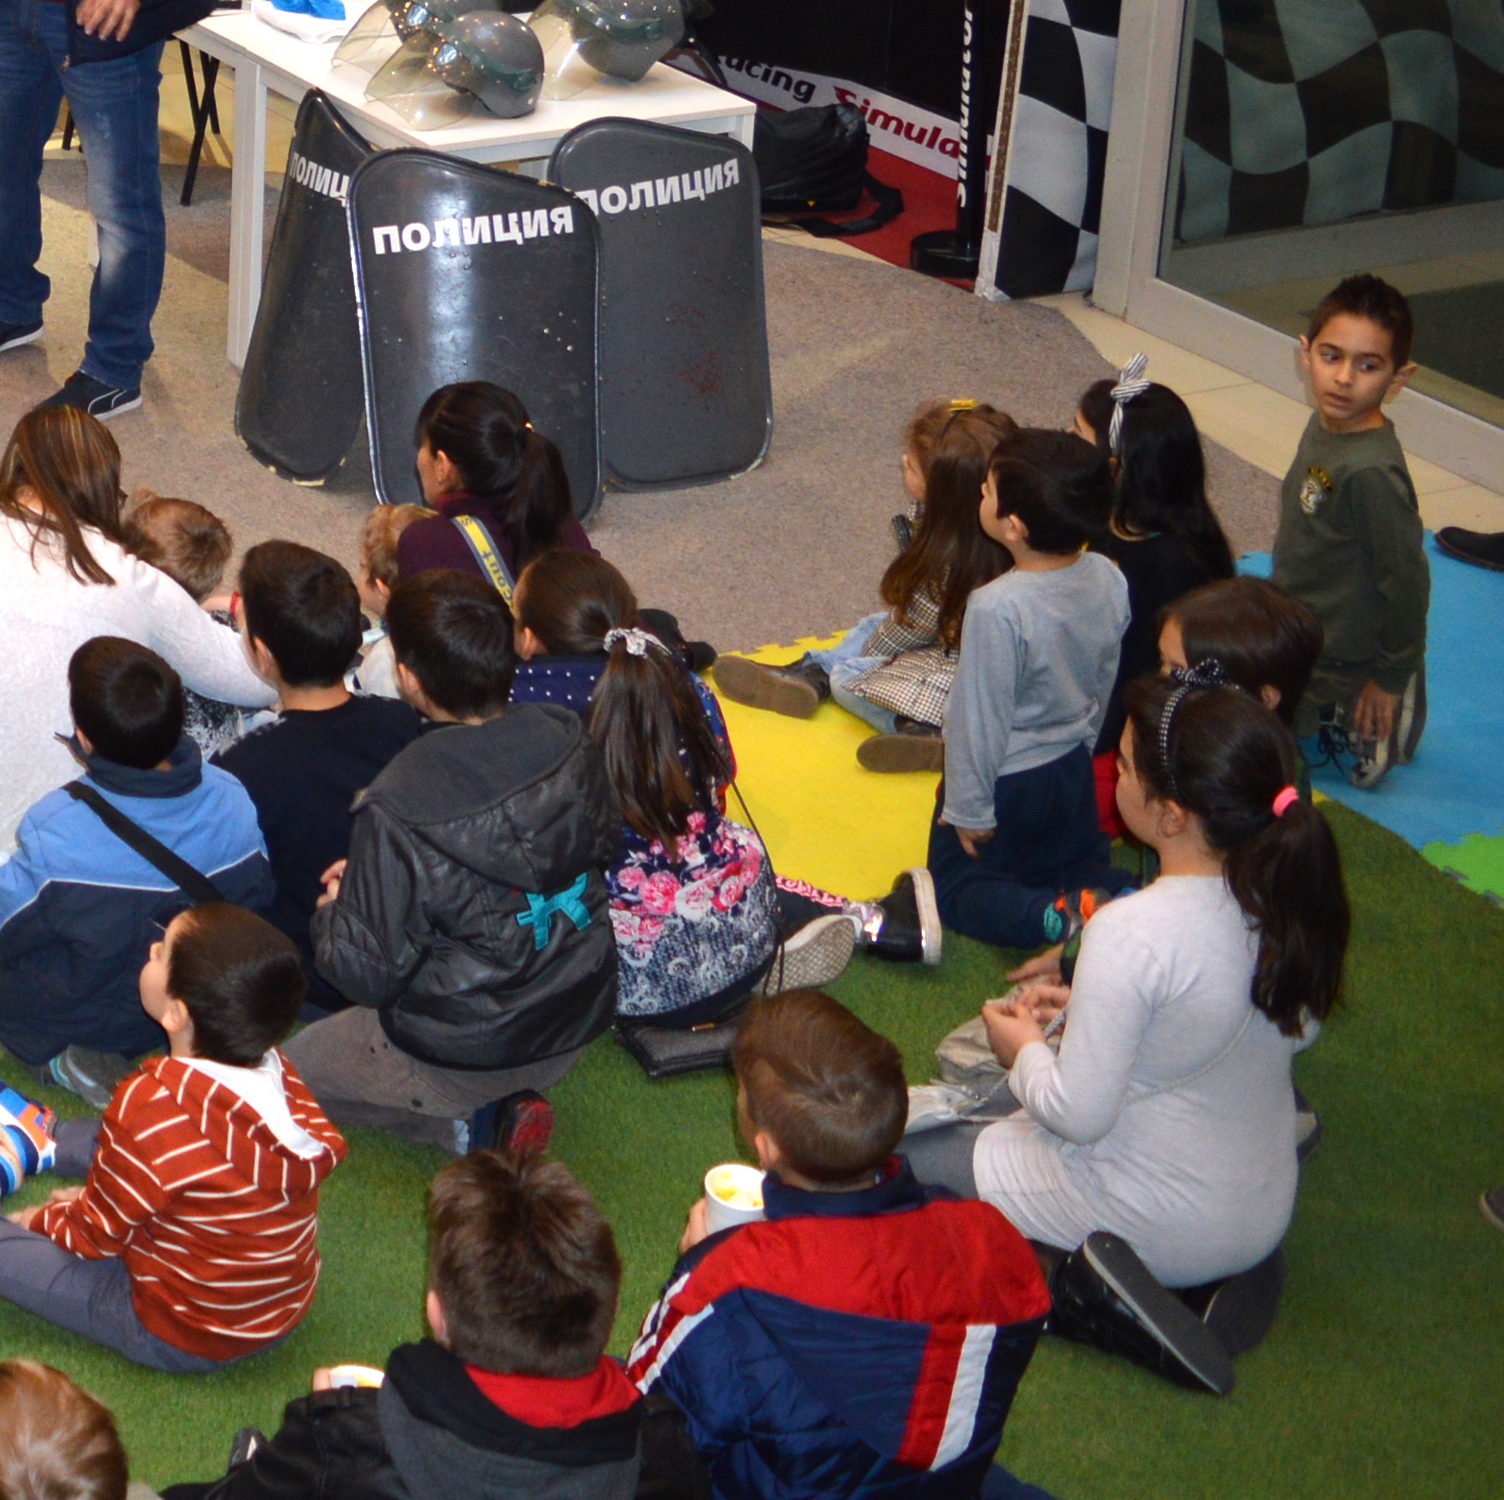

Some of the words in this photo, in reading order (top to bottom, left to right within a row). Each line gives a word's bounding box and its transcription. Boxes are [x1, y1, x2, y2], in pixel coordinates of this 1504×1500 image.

[715, 54, 816, 104] acing
[290, 152, 350, 207] ПОЛИЦ
[576, 158, 740, 216] ПОЛИЦИЯ
[373, 206, 574, 256] ПОЛИЦИЯ
